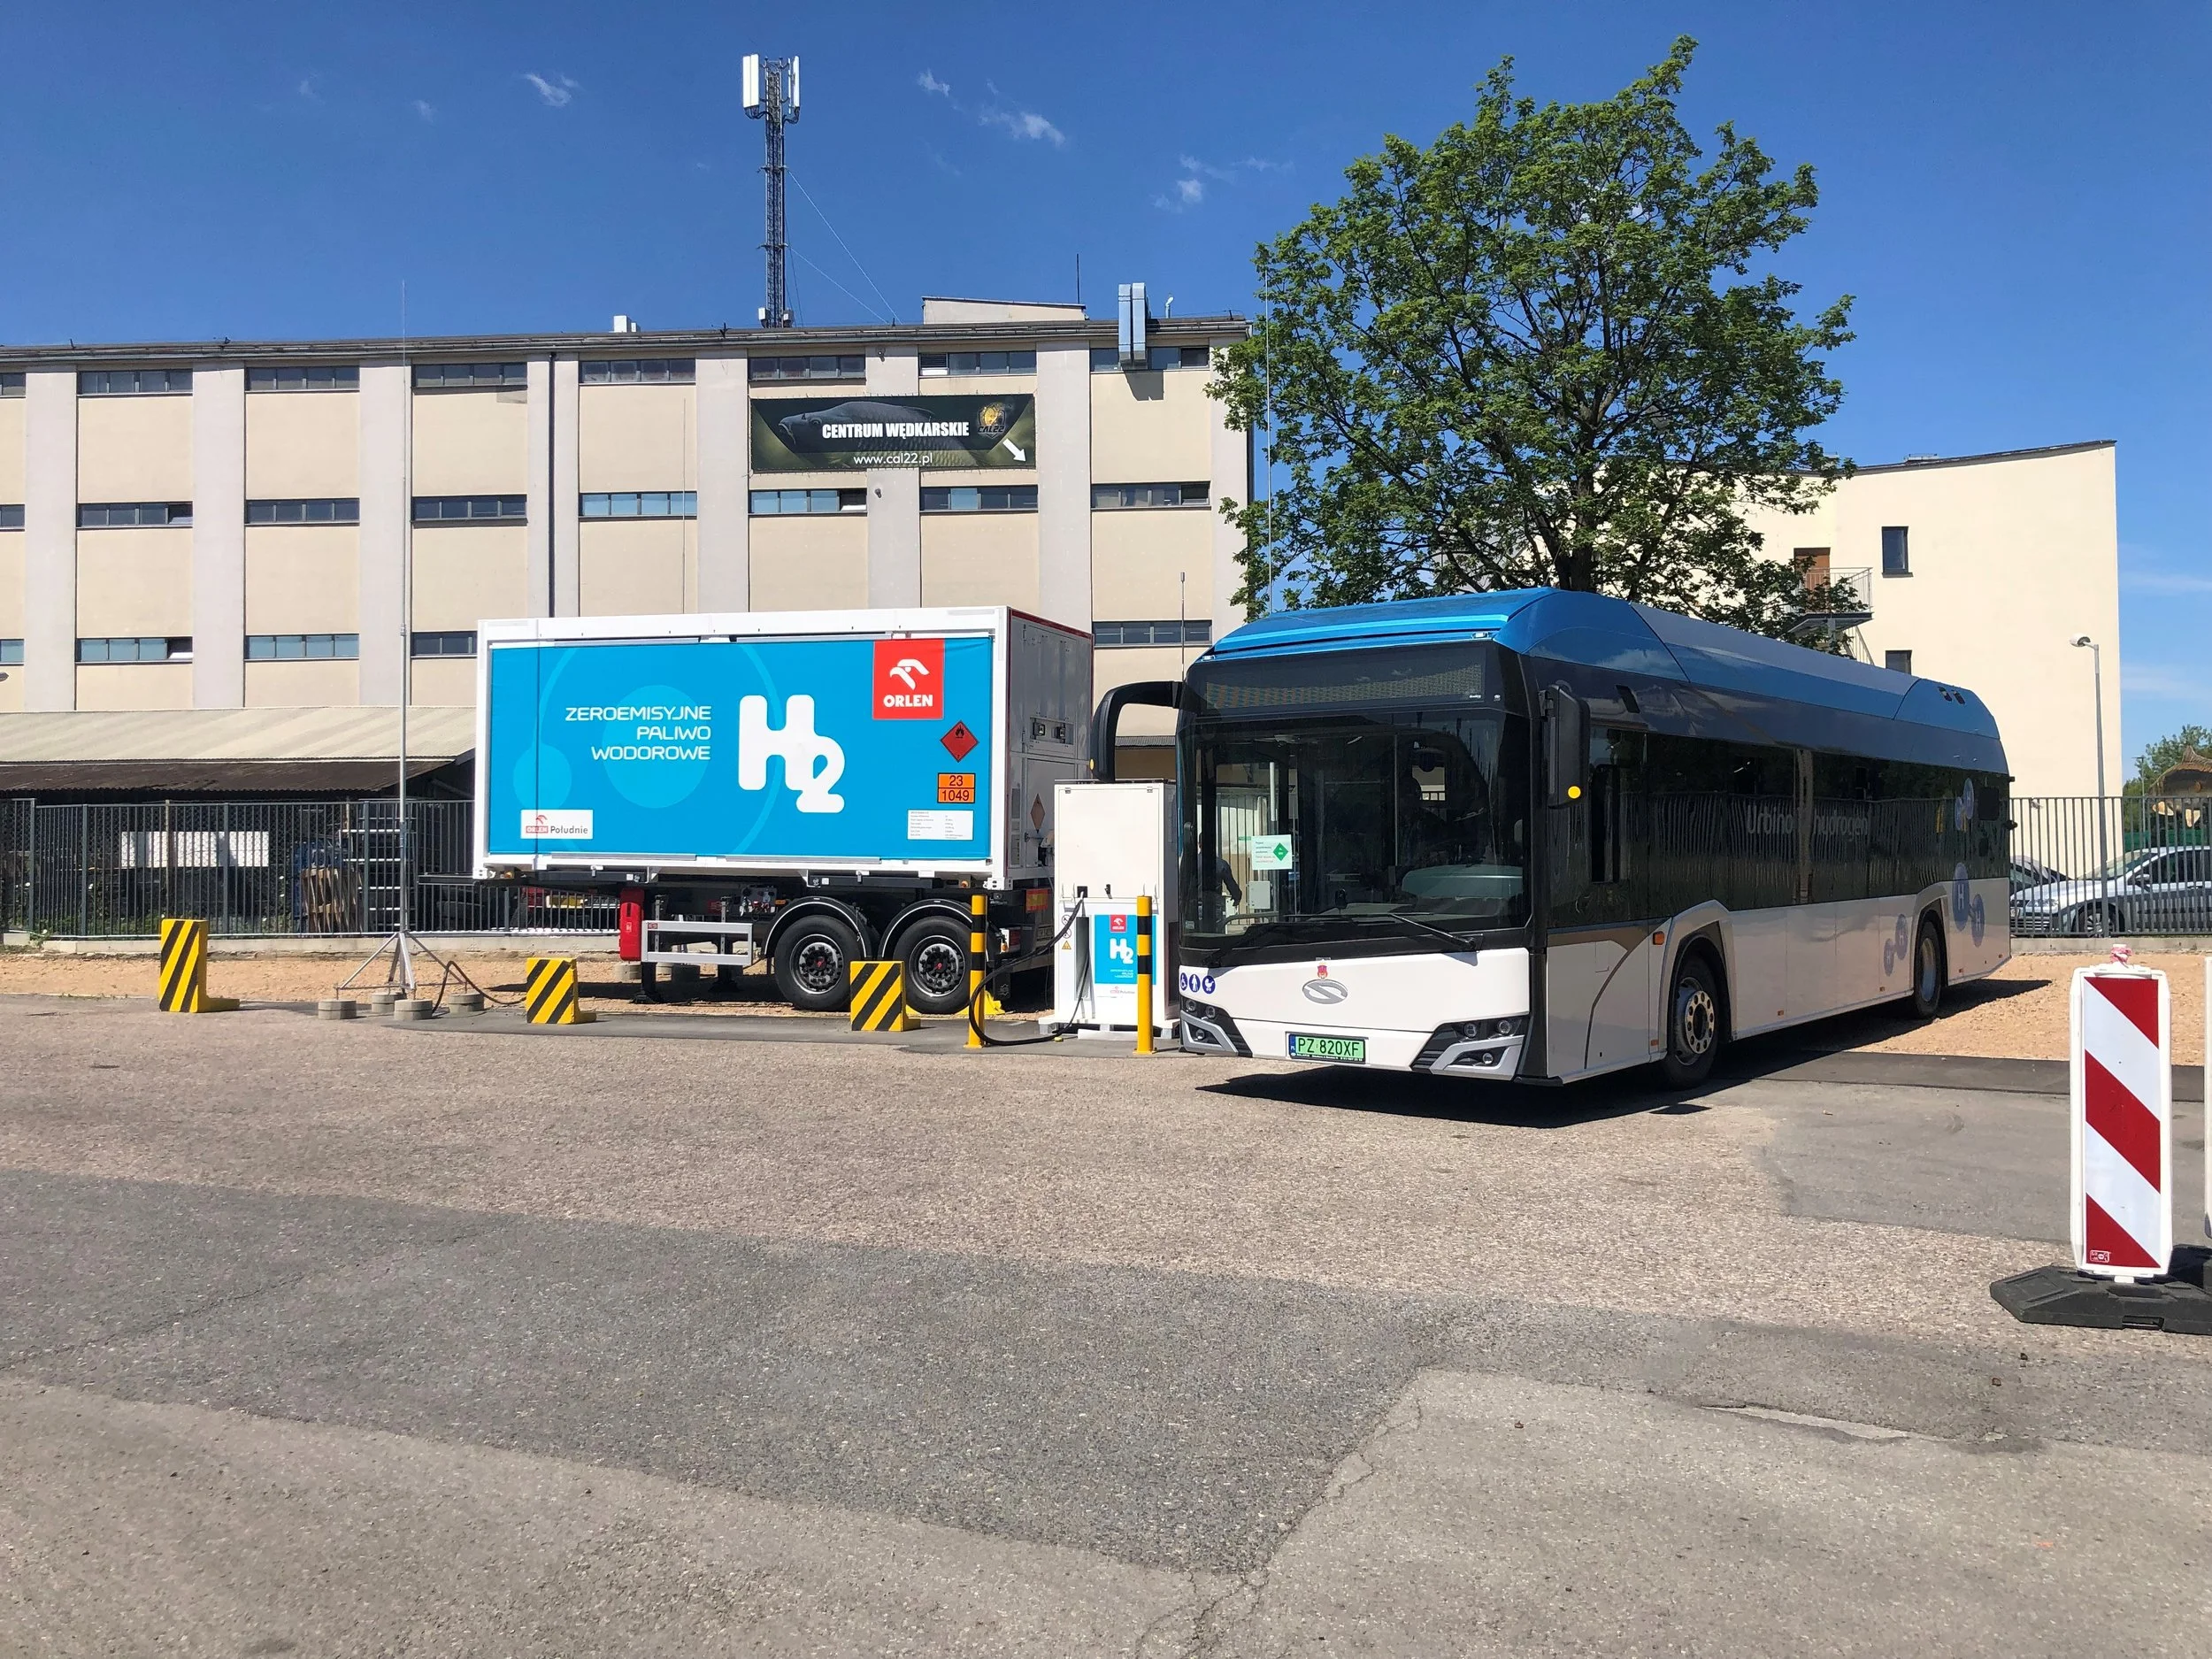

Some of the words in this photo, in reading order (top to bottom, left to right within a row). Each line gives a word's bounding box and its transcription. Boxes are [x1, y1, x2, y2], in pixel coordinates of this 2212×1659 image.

[822, 424, 883, 439] CENTRUM
[886, 421, 970, 441] WĘDKARSKIE
[978, 425, 1005, 434] CAL22
[853, 452, 933, 466] www.cal22.pl
[883, 695, 933, 708] ORLEN
[565, 705, 712, 722] ZEROEMISYJNE
[636, 726, 712, 741] PALIWO
[591, 746, 711, 762] WODOROWE
[949, 775, 964, 787] 23
[941, 789, 970, 802] 1049
[1747, 804, 1793, 834] Urbino
[1298, 1038, 1315, 1053] PZ
[1319, 1040, 1360, 1056] 820XF
